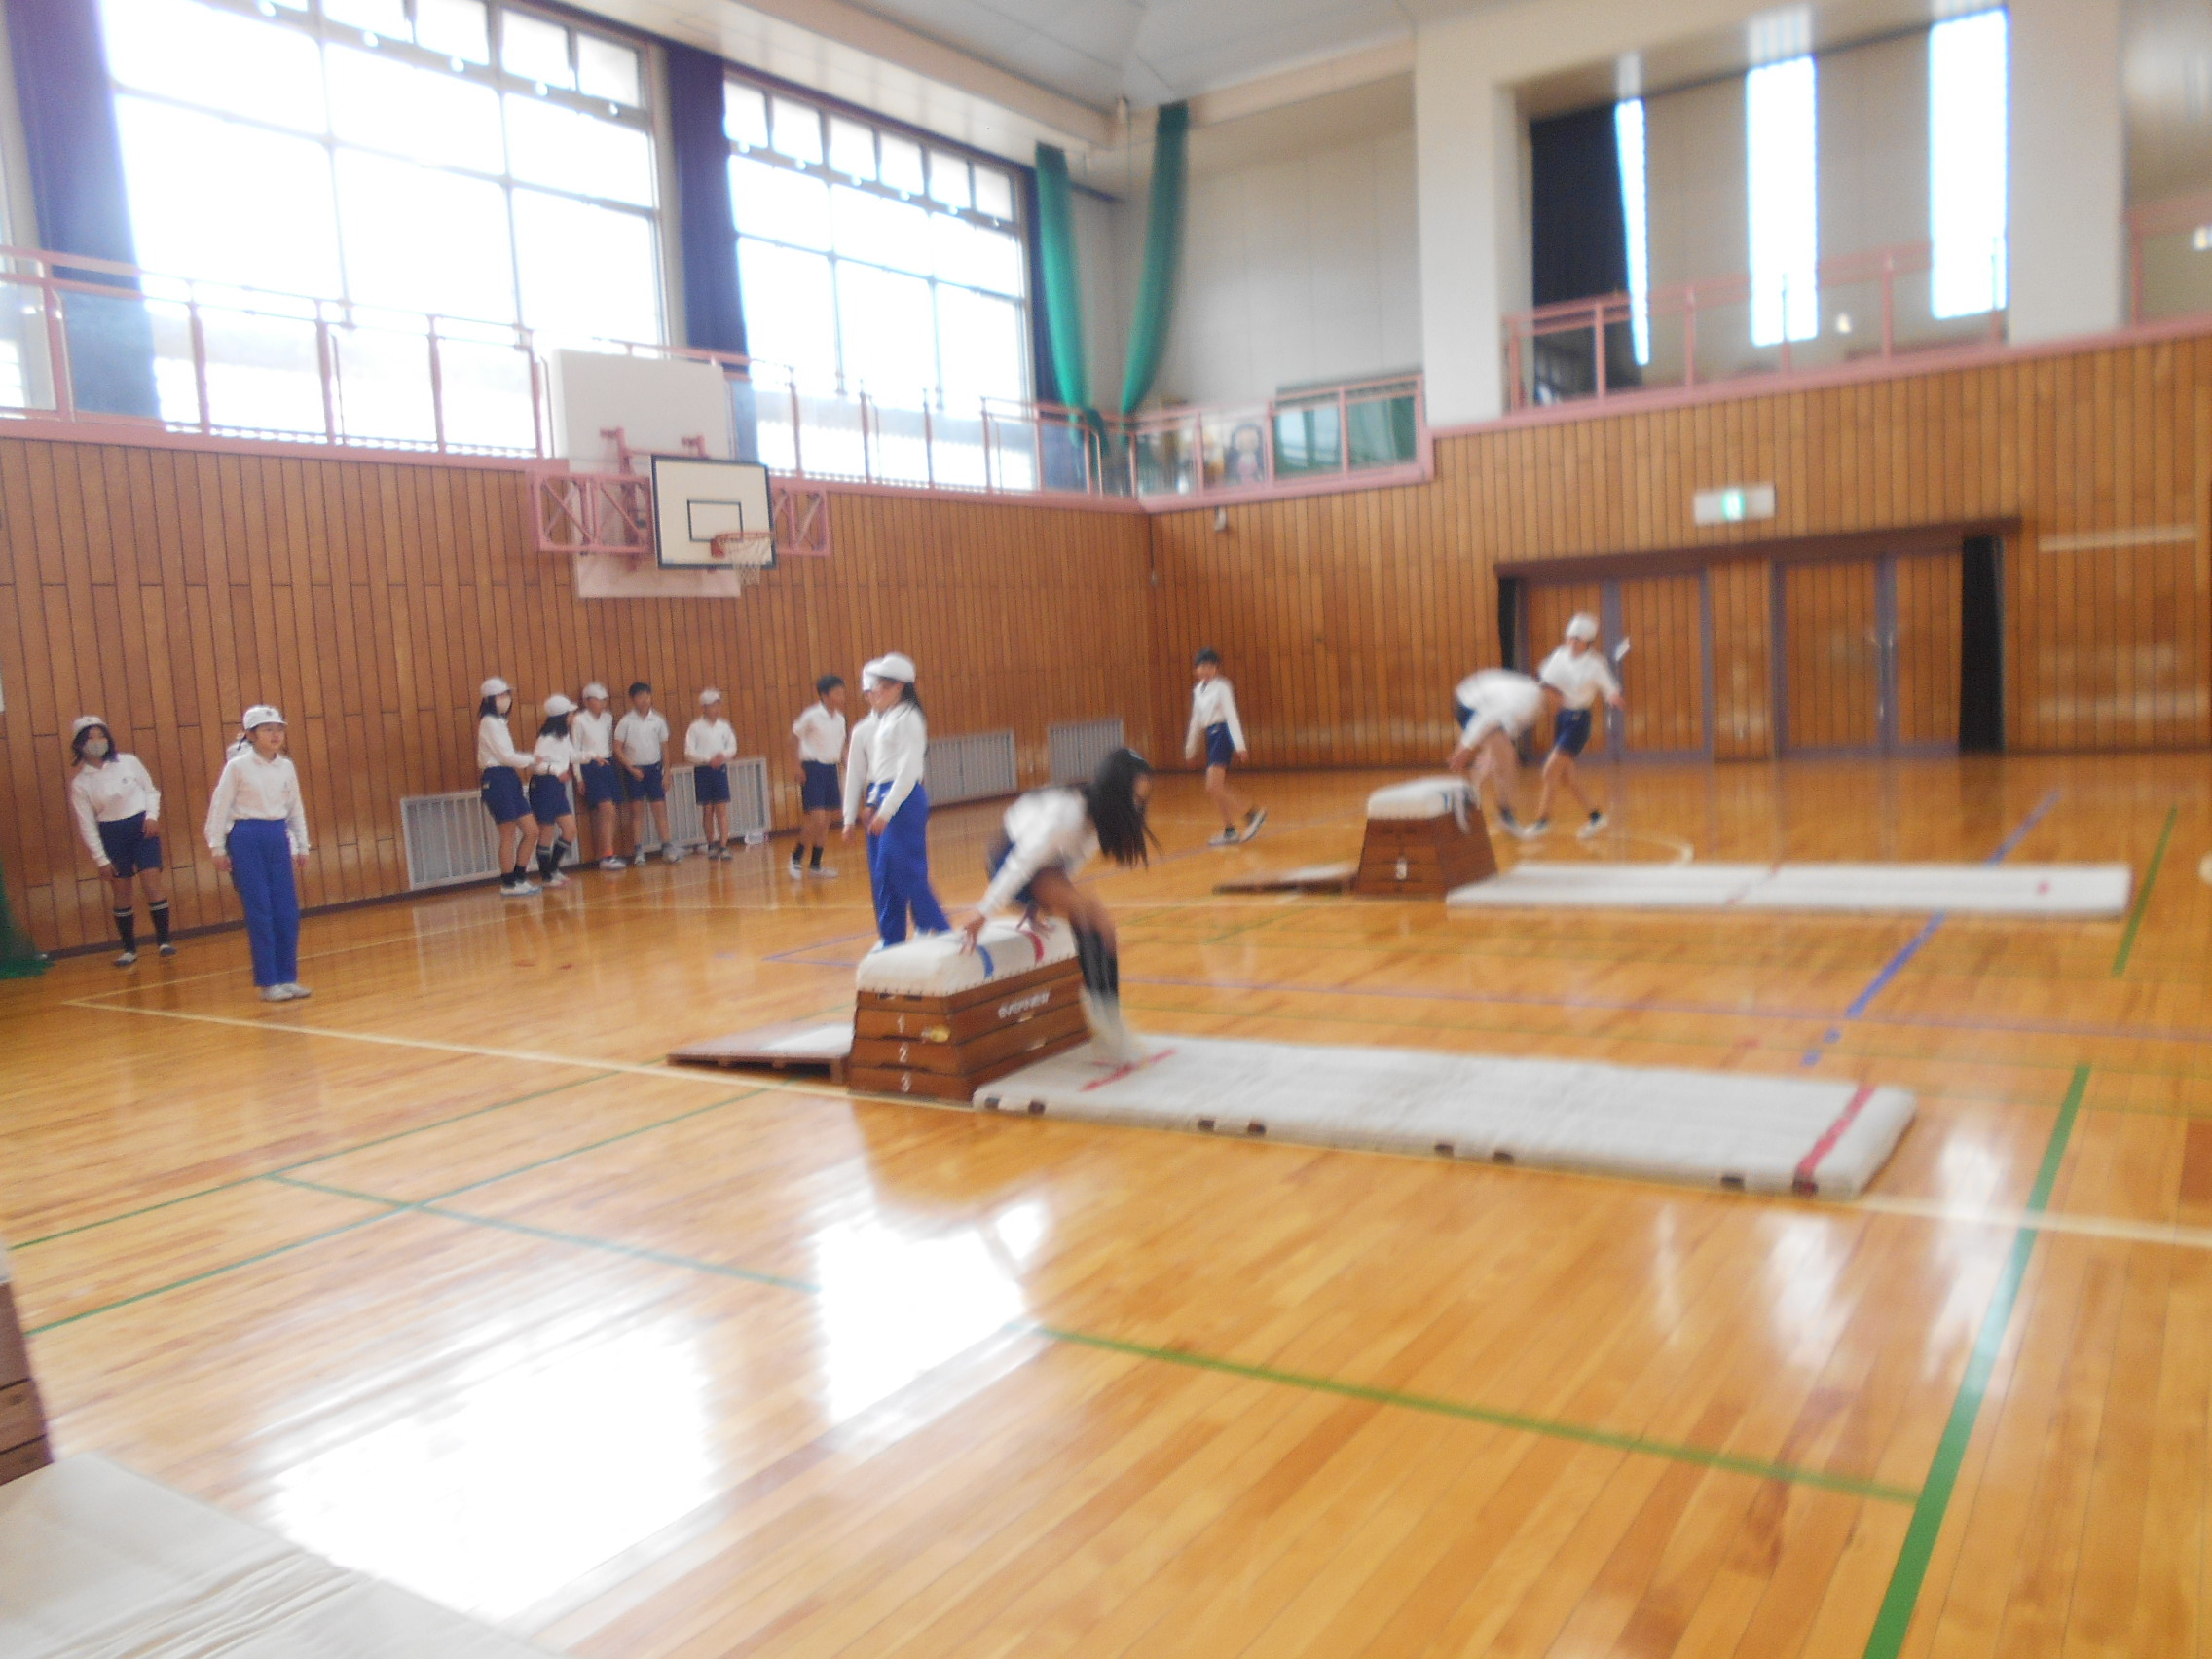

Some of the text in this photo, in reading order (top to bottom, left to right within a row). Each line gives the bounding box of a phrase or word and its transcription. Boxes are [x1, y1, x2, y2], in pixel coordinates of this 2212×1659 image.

[897, 1014, 905, 1033] 1
[899, 1042, 909, 1062] 2
[901, 1071, 912, 1092] 3
